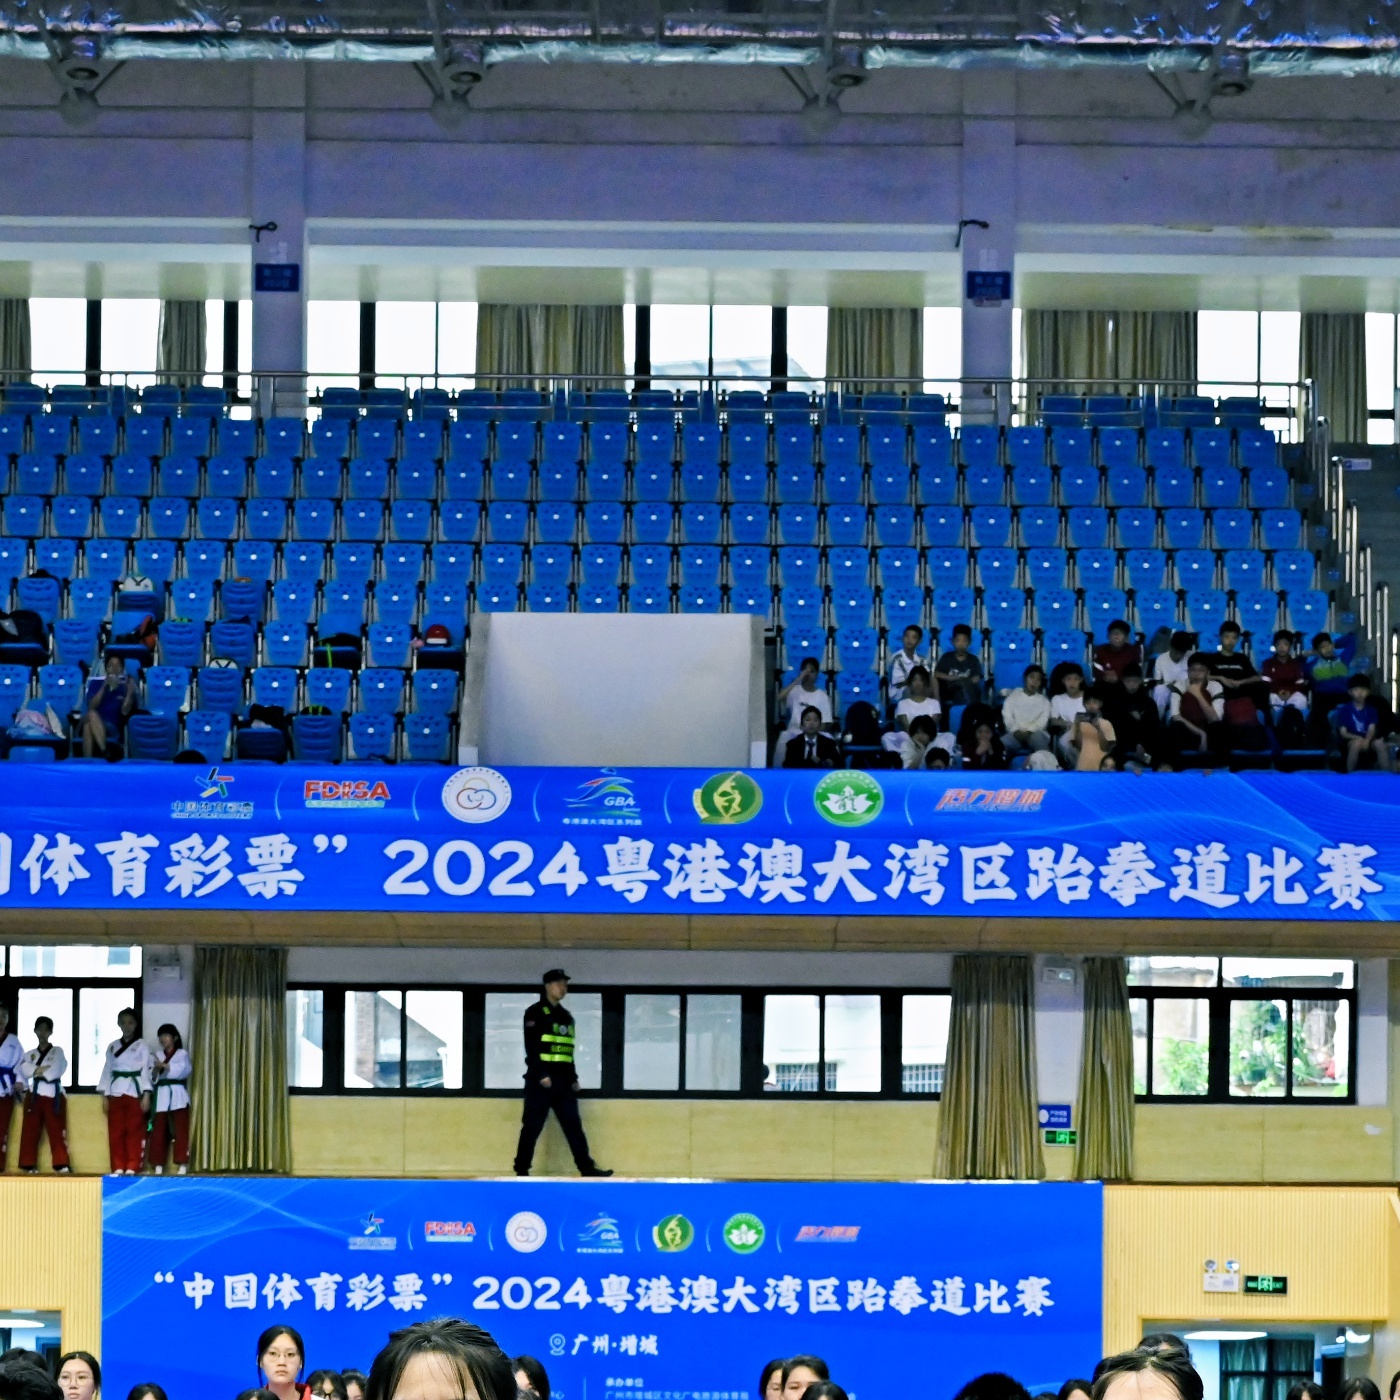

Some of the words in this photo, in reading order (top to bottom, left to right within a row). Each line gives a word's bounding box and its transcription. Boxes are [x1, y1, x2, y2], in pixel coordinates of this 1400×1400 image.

[603, 796, 636, 807] GBA
[383, 835, 1382, 911] 2024粤港澳大湾区跆拳道比赛
[153, 1271, 453, 1313] “中国体育彩票”
[472, 1271, 1051, 1318] 2024粤港澳大湾区跆拳道比赛
[571, 1333, 659, 1356] 广州·增城
